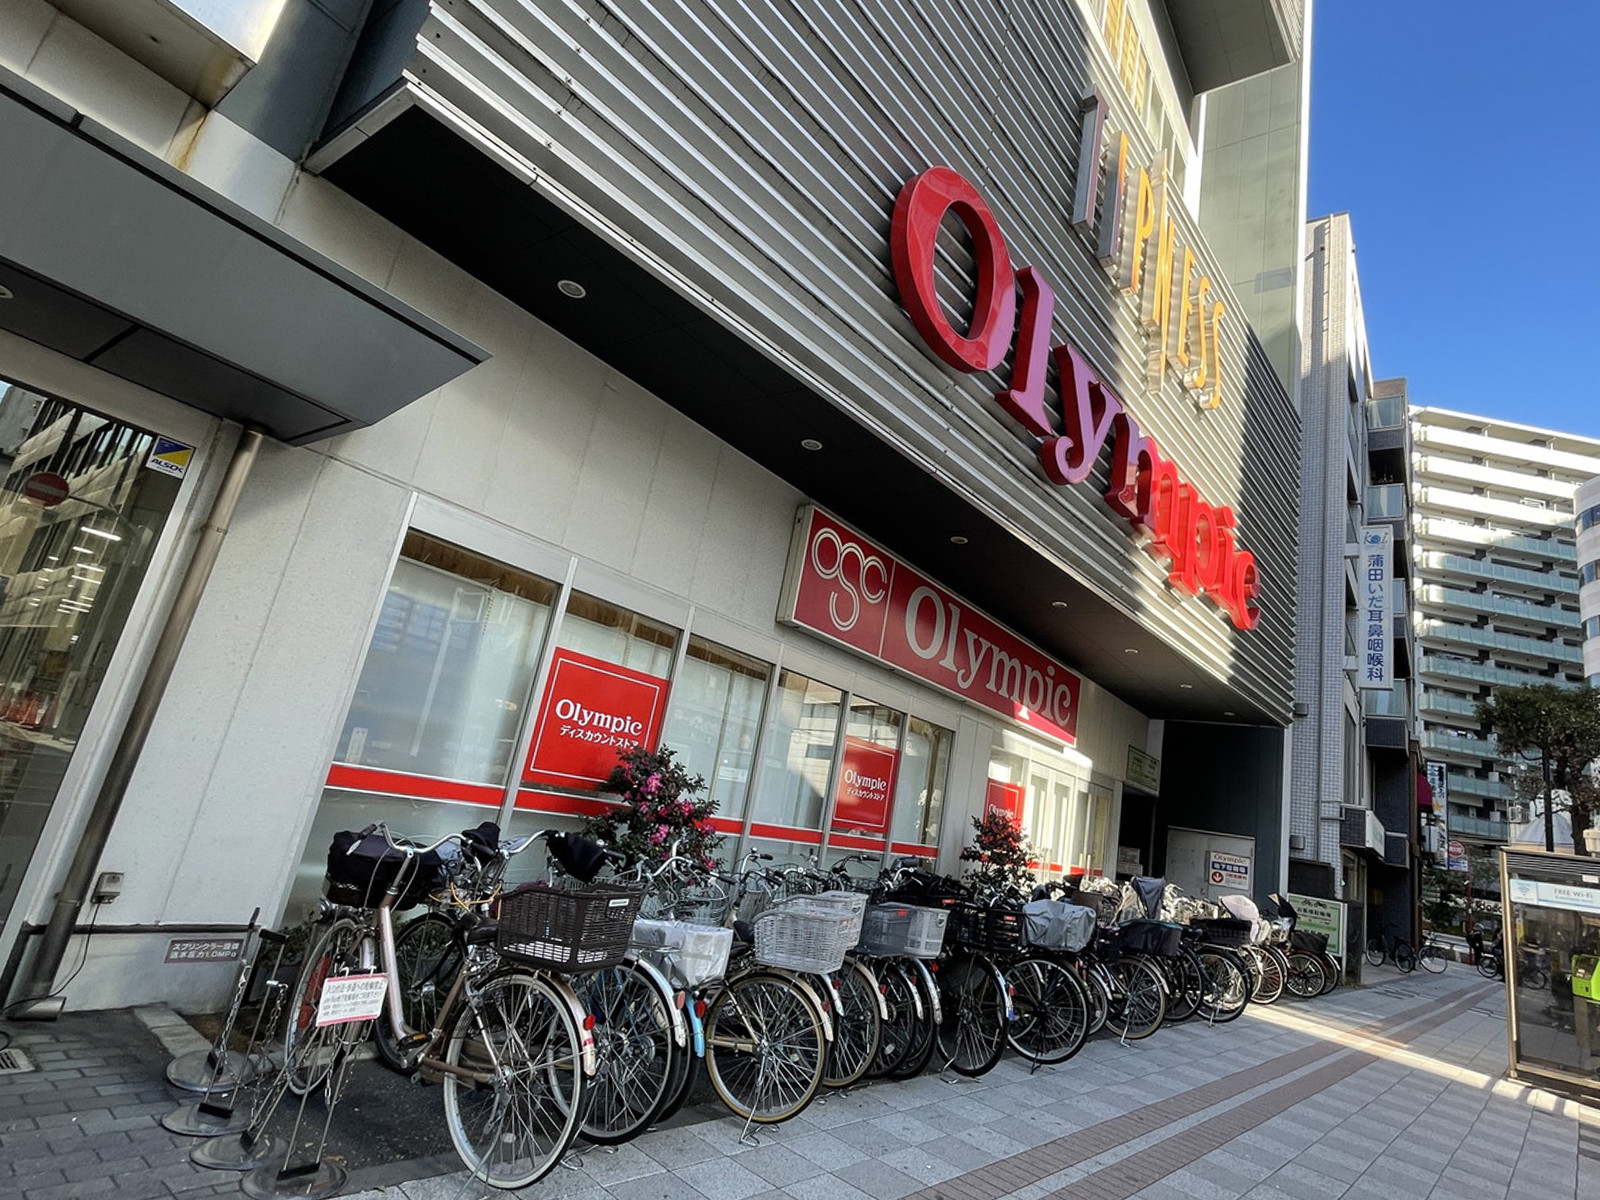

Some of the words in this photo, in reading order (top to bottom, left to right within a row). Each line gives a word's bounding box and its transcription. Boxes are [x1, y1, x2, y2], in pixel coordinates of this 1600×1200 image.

[890, 165, 1260, 630] Olympic
[151, 458, 184, 473] ALSOK
[1367, 554, 1384, 682] 蒲田いだ耳鼻咽喉科
[905, 585, 1072, 727] Olympic
[555, 699, 643, 736] Olympic
[844, 769, 887, 791] Olympic
[1213, 853, 1246, 865] Olympic
[1554, 888, 1570, 896] FREE
